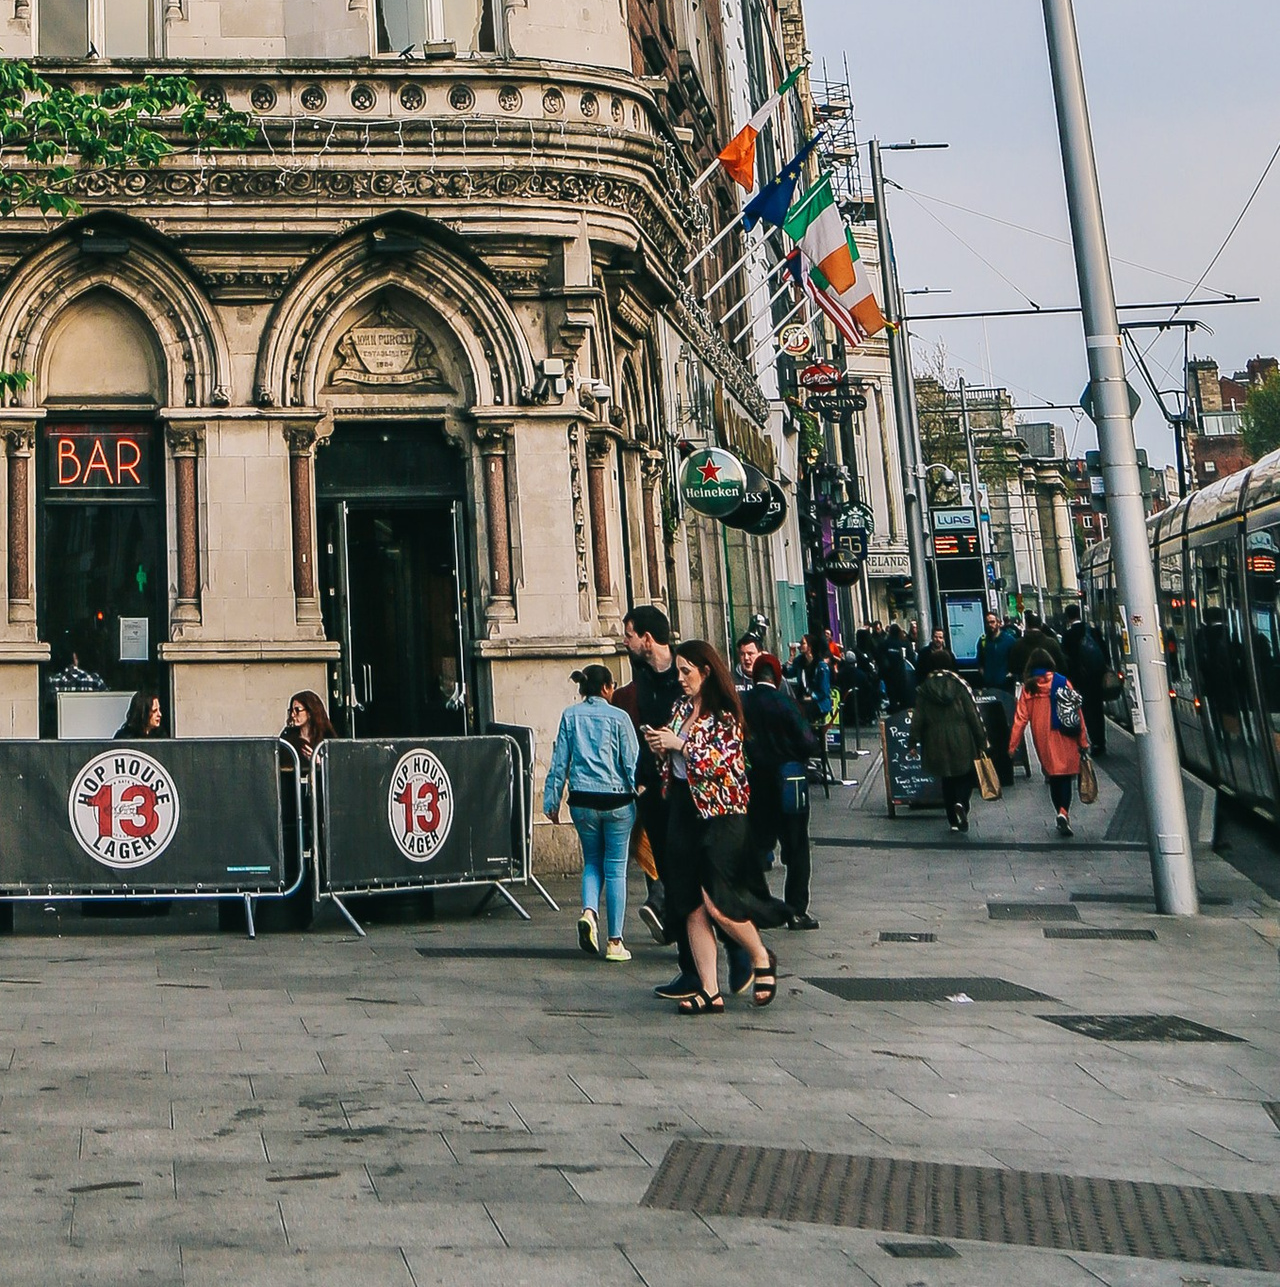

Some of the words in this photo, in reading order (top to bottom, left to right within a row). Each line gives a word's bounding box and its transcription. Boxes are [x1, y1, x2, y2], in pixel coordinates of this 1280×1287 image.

[58, 438, 141, 484] BAR
[686, 486, 739, 498] Heineken
[937, 515, 971, 525] LUAS
[867, 556, 909, 567] RELANDS
[77, 766, 106, 807] HOP
[114, 757, 170, 806] HOUSE
[393, 764, 410, 804] HOP
[413, 757, 448, 802] HOUSE
[87, 784, 159, 838] 13
[399, 782, 441, 833] 13
[93, 834, 158, 859] LAGER
[402, 830, 440, 853] LAGER
